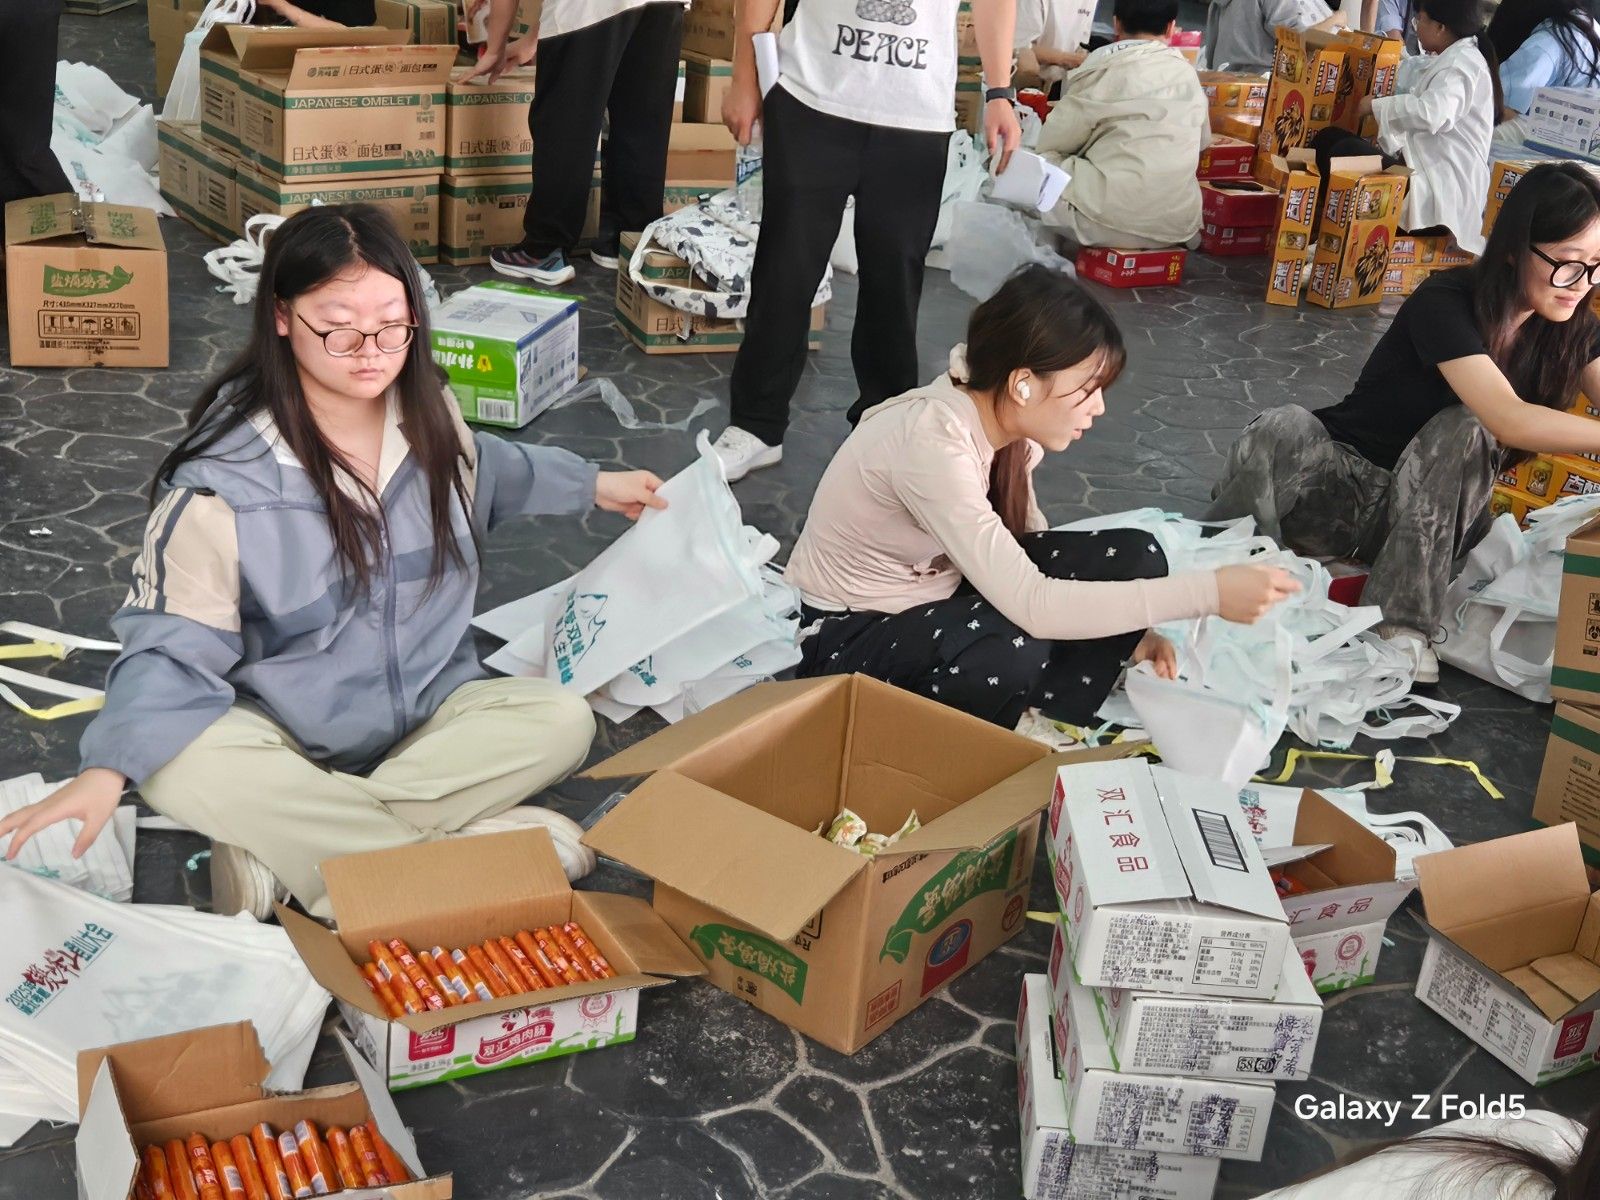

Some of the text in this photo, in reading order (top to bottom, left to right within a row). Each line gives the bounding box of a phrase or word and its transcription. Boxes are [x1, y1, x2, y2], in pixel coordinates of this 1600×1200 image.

[832, 24, 929, 70] PEACE
[291, 96, 413, 109] JAPANESE OMELET
[460, 93, 520, 105] JAPANESE
[290, 187, 406, 204] JAPANESE OMELET
[1096, 787, 1149, 873] 双汇食品
[482, 1024, 547, 1057] 双汇鸡肉肠
